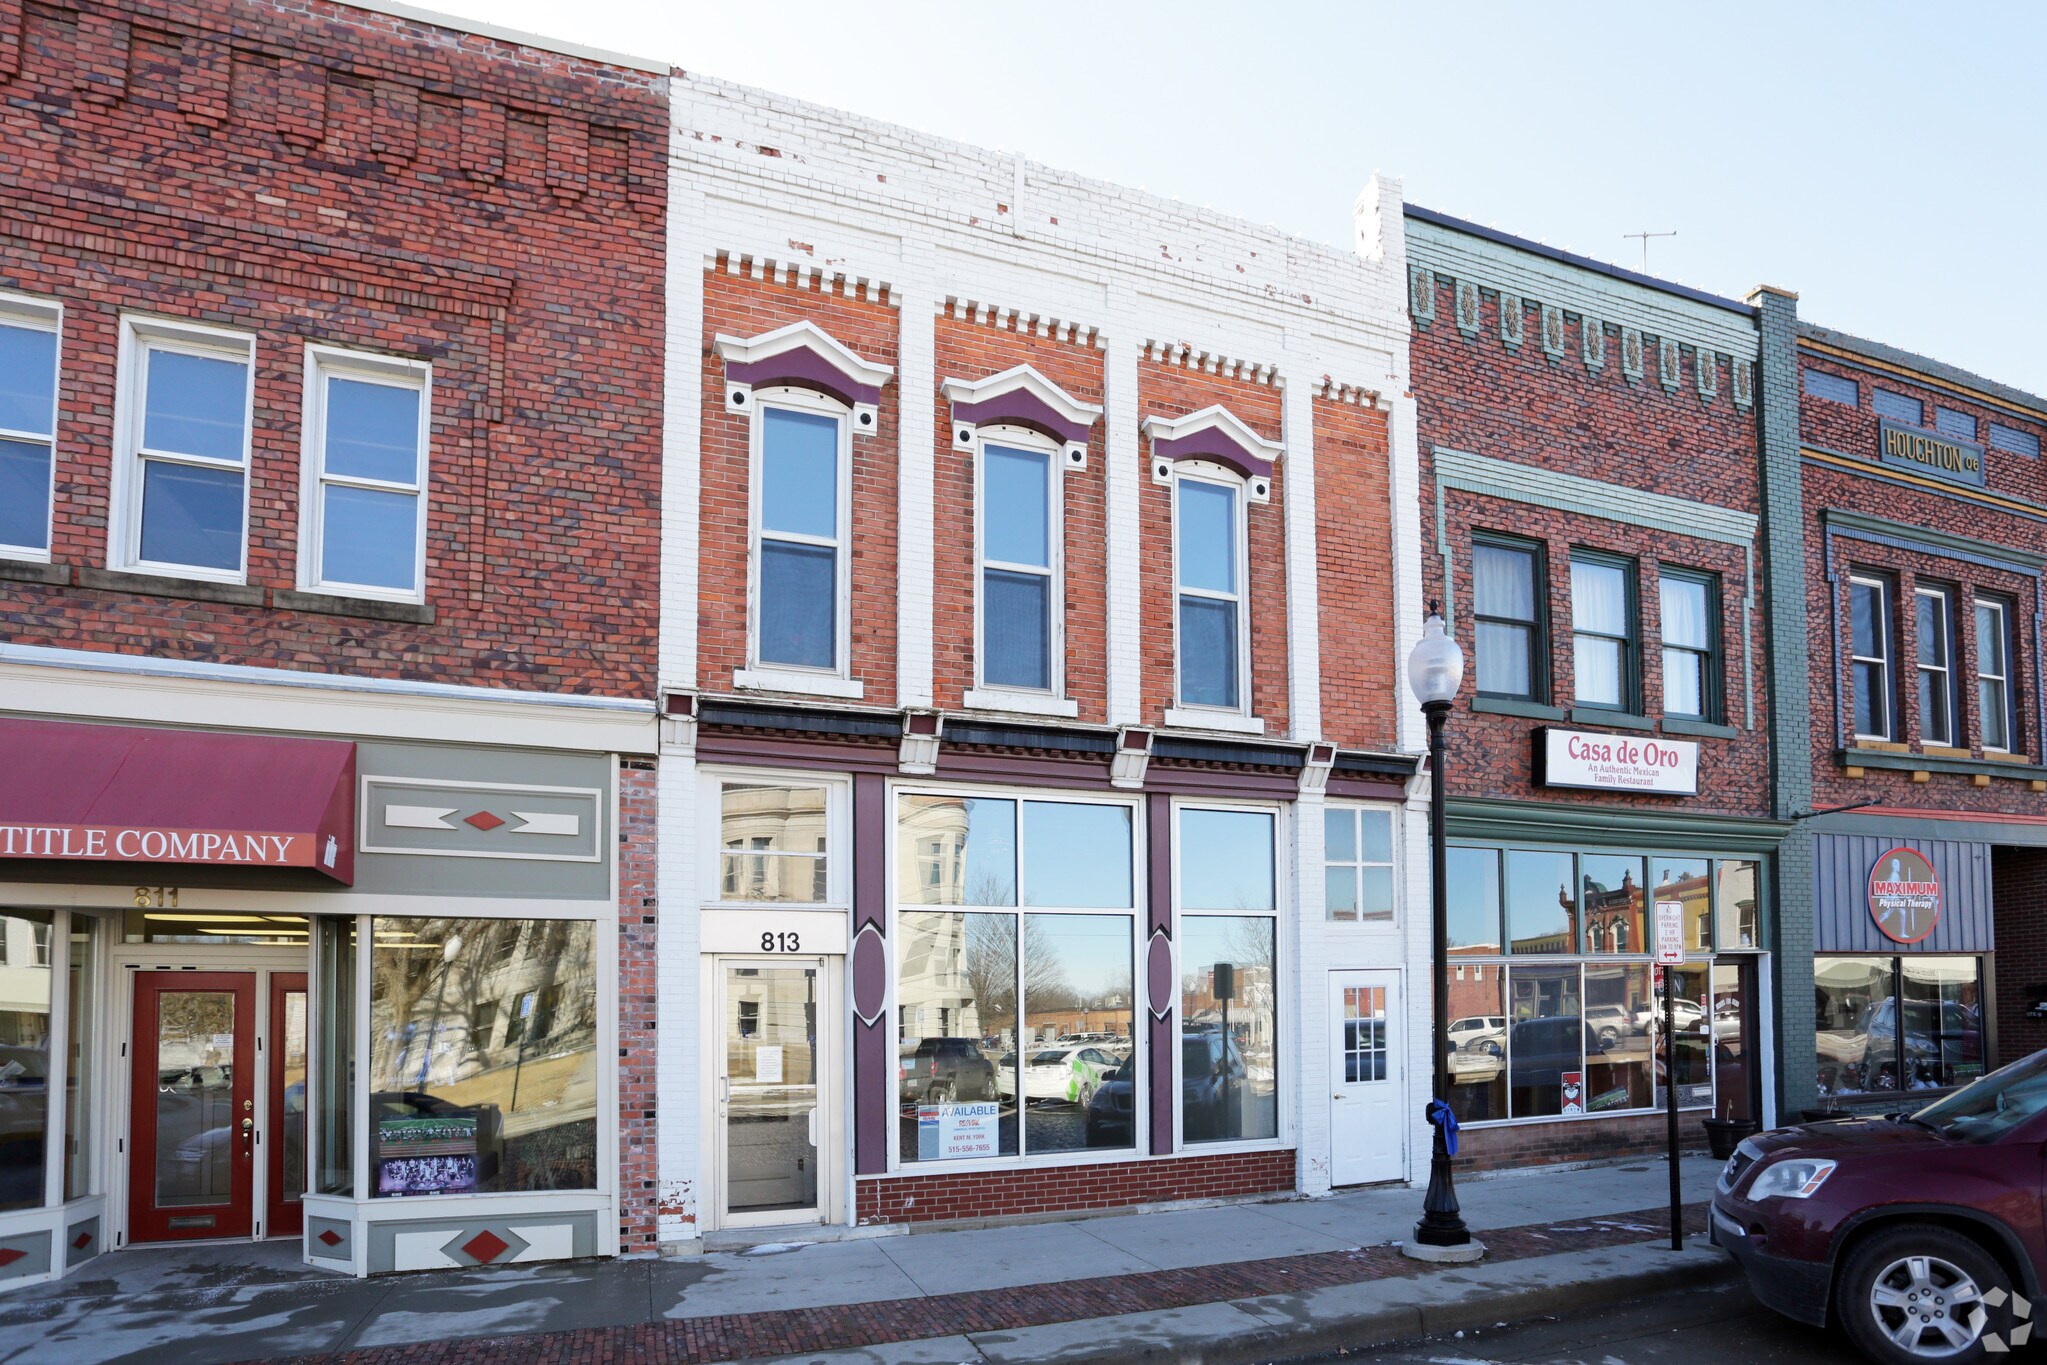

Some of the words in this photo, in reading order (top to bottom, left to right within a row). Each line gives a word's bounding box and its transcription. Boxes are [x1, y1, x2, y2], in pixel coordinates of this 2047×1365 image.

[1885, 427, 1962, 472] HOUGHTON
[1568, 735, 1612, 762] Casa
[1616, 740, 1639, 765] de
[1643, 742, 1679, 768] Oro
[1587, 763, 1599, 773] An
[1599, 764, 1633, 775] Authentic
[1632, 767, 1660, 777] Mexican
[1594, 773, 1617, 785] Family
[1617, 775, 1654, 786] Restaurant
[0, 826, 108, 858] TITLE
[116, 829, 295, 862] COMPANY
[1873, 881, 1939, 896] MAXIMUM
[133, 887, 178, 908] 811
[1879, 898, 1906, 909] Physical
[1907, 899, 1932, 909] Therapy
[761, 932, 800, 952] 813
[942, 1105, 996, 1117] AVAILABLE
